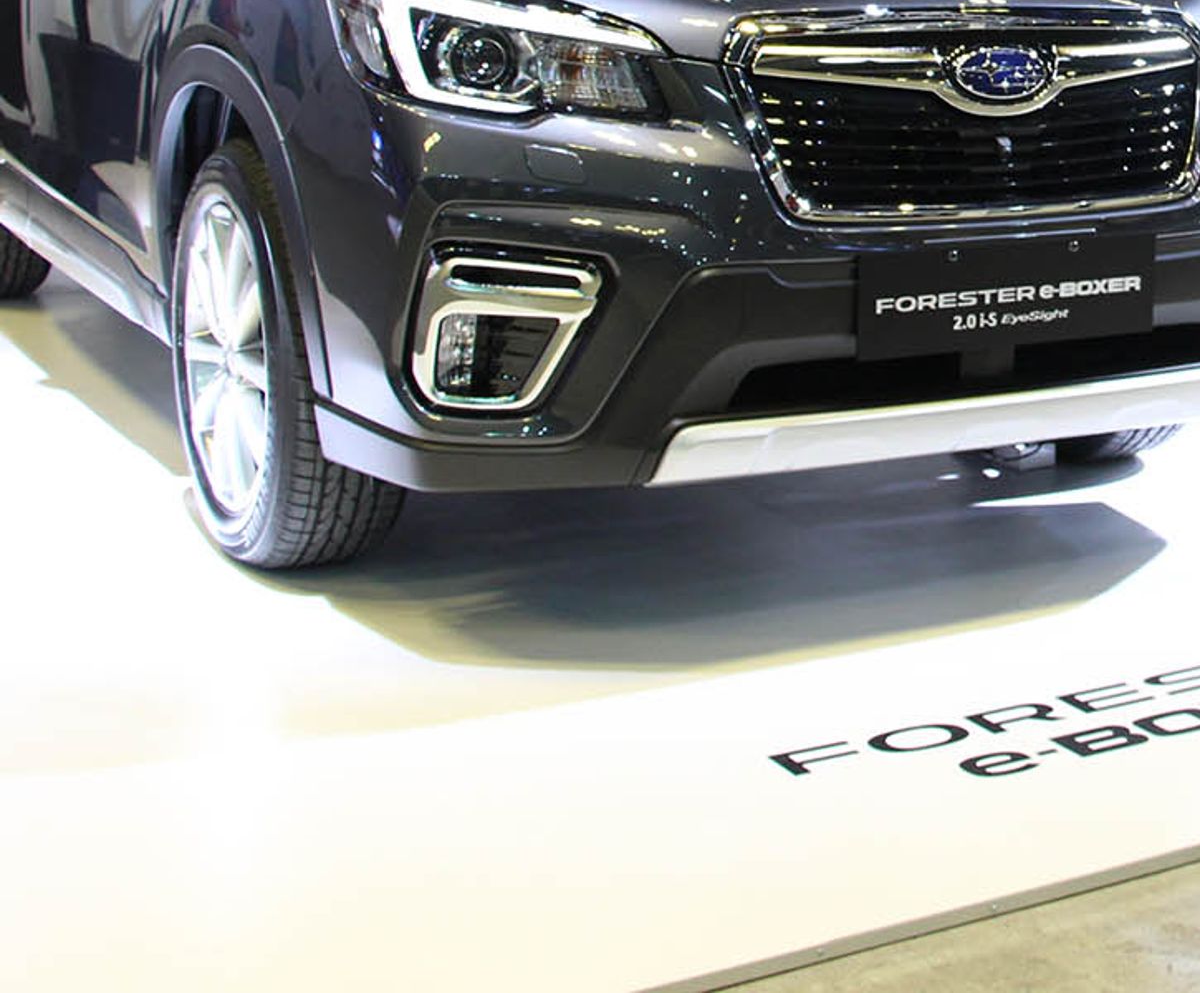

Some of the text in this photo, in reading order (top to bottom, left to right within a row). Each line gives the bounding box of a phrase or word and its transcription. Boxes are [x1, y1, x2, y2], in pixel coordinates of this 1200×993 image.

[875, 275, 1142, 315] FORESTER e-BOXER
[953, 313, 976, 330] 2.0
[1001, 308, 1069, 325] EyeSight
